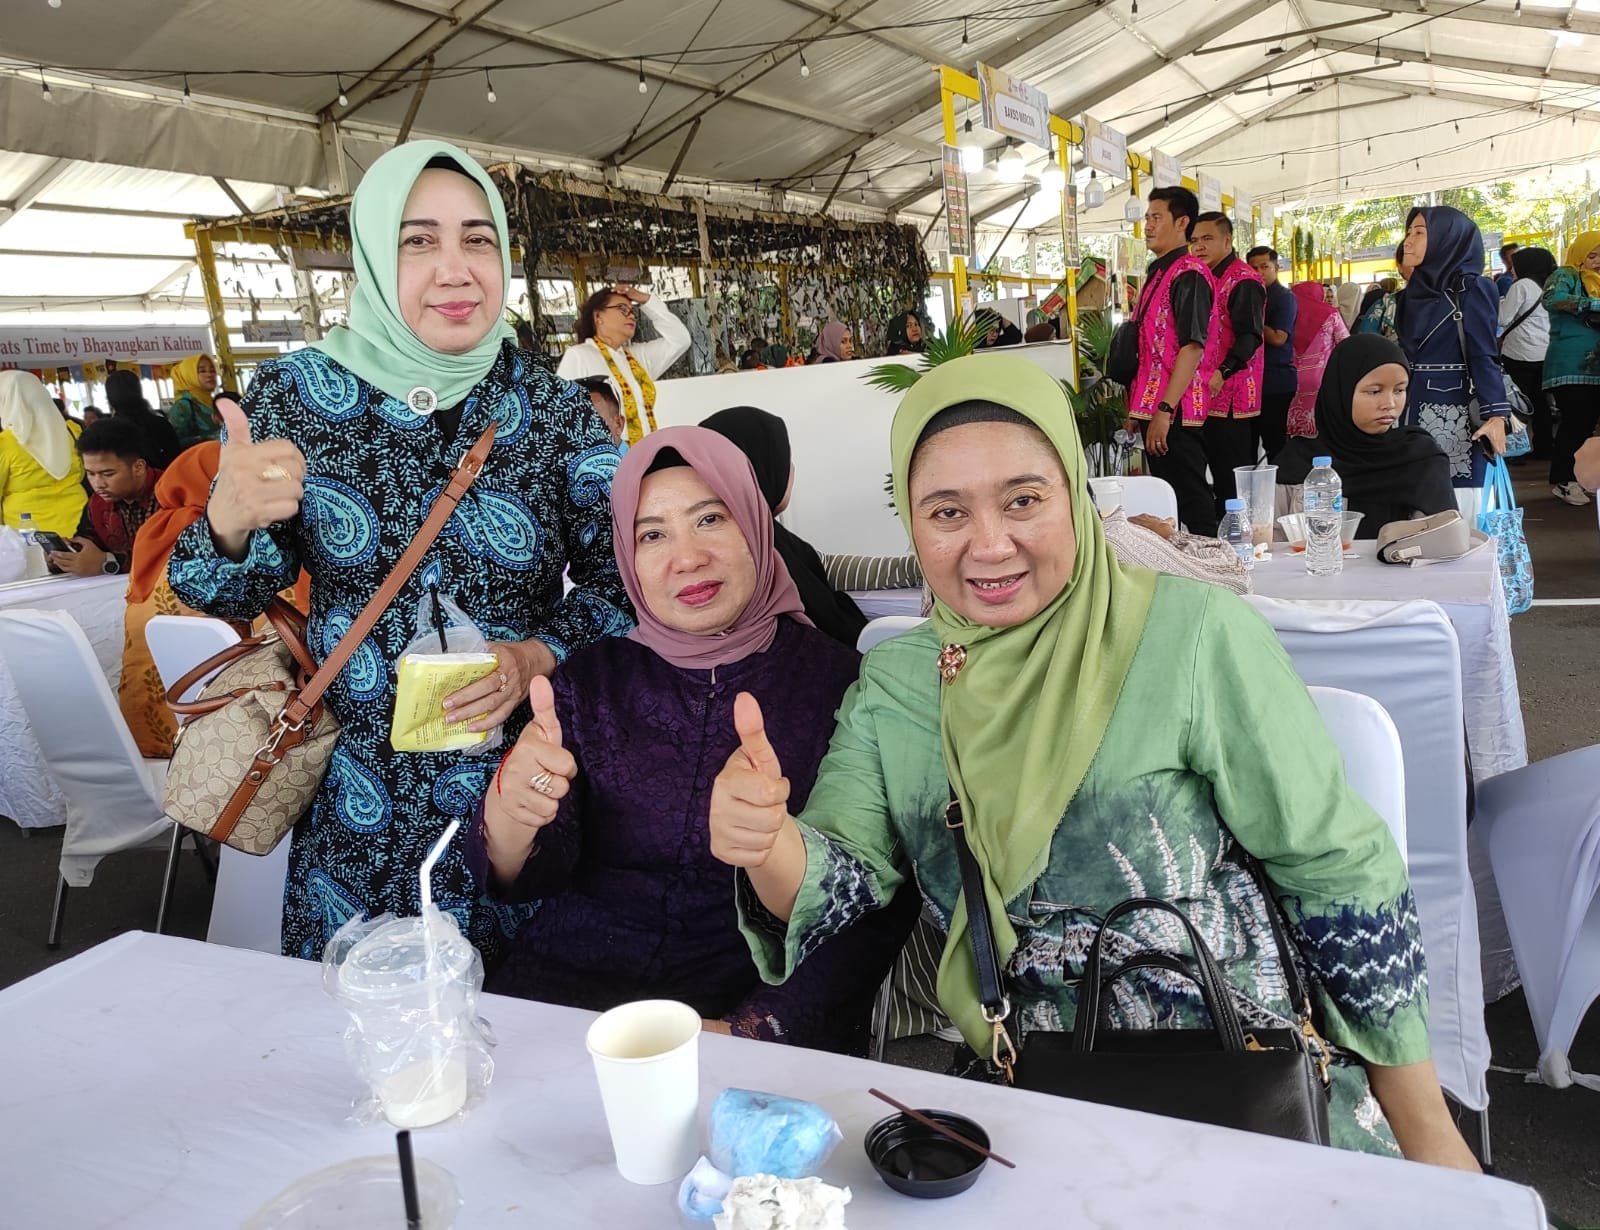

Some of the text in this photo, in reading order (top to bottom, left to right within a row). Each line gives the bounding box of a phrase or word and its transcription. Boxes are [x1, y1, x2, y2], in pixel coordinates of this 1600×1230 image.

[1, 336, 202, 357] ats Time by Bhayangkari Kaltim
